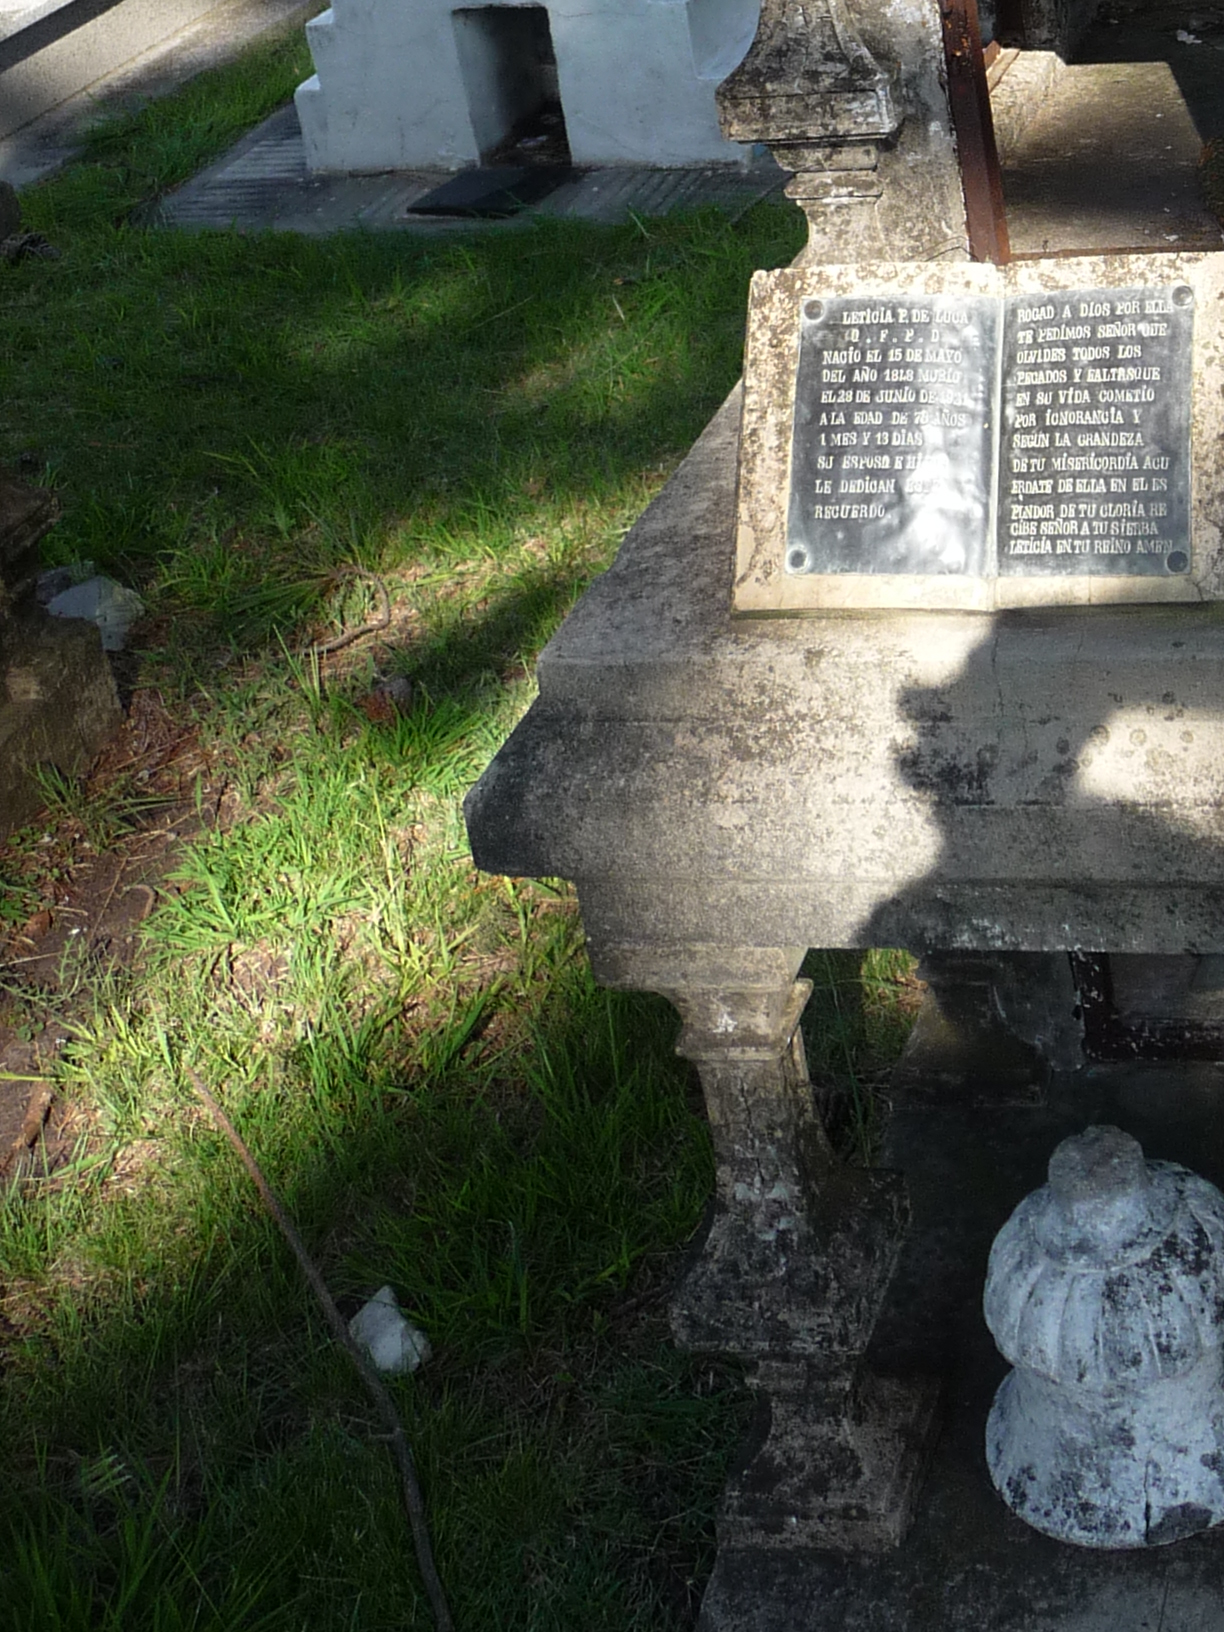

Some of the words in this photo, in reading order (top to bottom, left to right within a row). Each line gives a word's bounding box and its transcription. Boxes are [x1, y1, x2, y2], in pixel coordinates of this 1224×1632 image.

[911, 309, 929, 324] DE
[1018, 305, 1054, 323] ROGAD
[1062, 305, 1071, 318] A
[1116, 301, 1140, 316] POR
[1017, 329, 1033, 345] TE
[1097, 322, 1135, 338] SEÑOR
[865, 349, 882, 363] EL
[888, 348, 902, 362] 15
[906, 349, 922, 362] DE
[925, 349, 962, 363] MAYO
[1017, 347, 1066, 364] OLVIDES
[1072, 346, 1110, 360] TODOS
[1117, 345, 1142, 359] LOS
[822, 370, 845, 383] DEL
[852, 366, 877, 383] AÑO
[1073, 368, 1082, 382] Y
[821, 390, 837, 403] EL
[855, 390, 870, 403] DE
[920, 390, 937, 403] DE
[1016, 393, 1030, 407] EN
[1036, 392, 1052, 405] SU
[819, 412, 828, 426] A
[830, 412, 845, 425] LA
[853, 411, 883, 425] EDAD
[892, 412, 908, 425] DE
[932, 409, 966, 427] AÑOS
[1015, 413, 1036, 428] POR
[1132, 409, 1142, 424] Y
[830, 432, 857, 446] MES
[862, 432, 871, 446] Y
[1054, 432, 1071, 447] LA
[1077, 432, 1144, 447] GRANDEZA
[817, 456, 835, 470] SU
[1013, 458, 1029, 472] DE
[1030, 458, 1046, 472] TU
[815, 479, 833, 494] LE
[1057, 478, 1073, 493] DE
[1075, 478, 1106, 493] ELLA
[1110, 478, 1126, 493] EN
[1132, 477, 1148, 492] EL
[1152, 478, 1167, 492] ES
[1060, 503, 1075, 518] DE
[1079, 504, 1096, 517] TU
[1040, 518, 1078, 535] SEÑOR
[1080, 521, 1090, 535] A
[1093, 521, 1108, 535] TU
[1056, 539, 1072, 554] EN
[1074, 539, 1091, 553] TU
